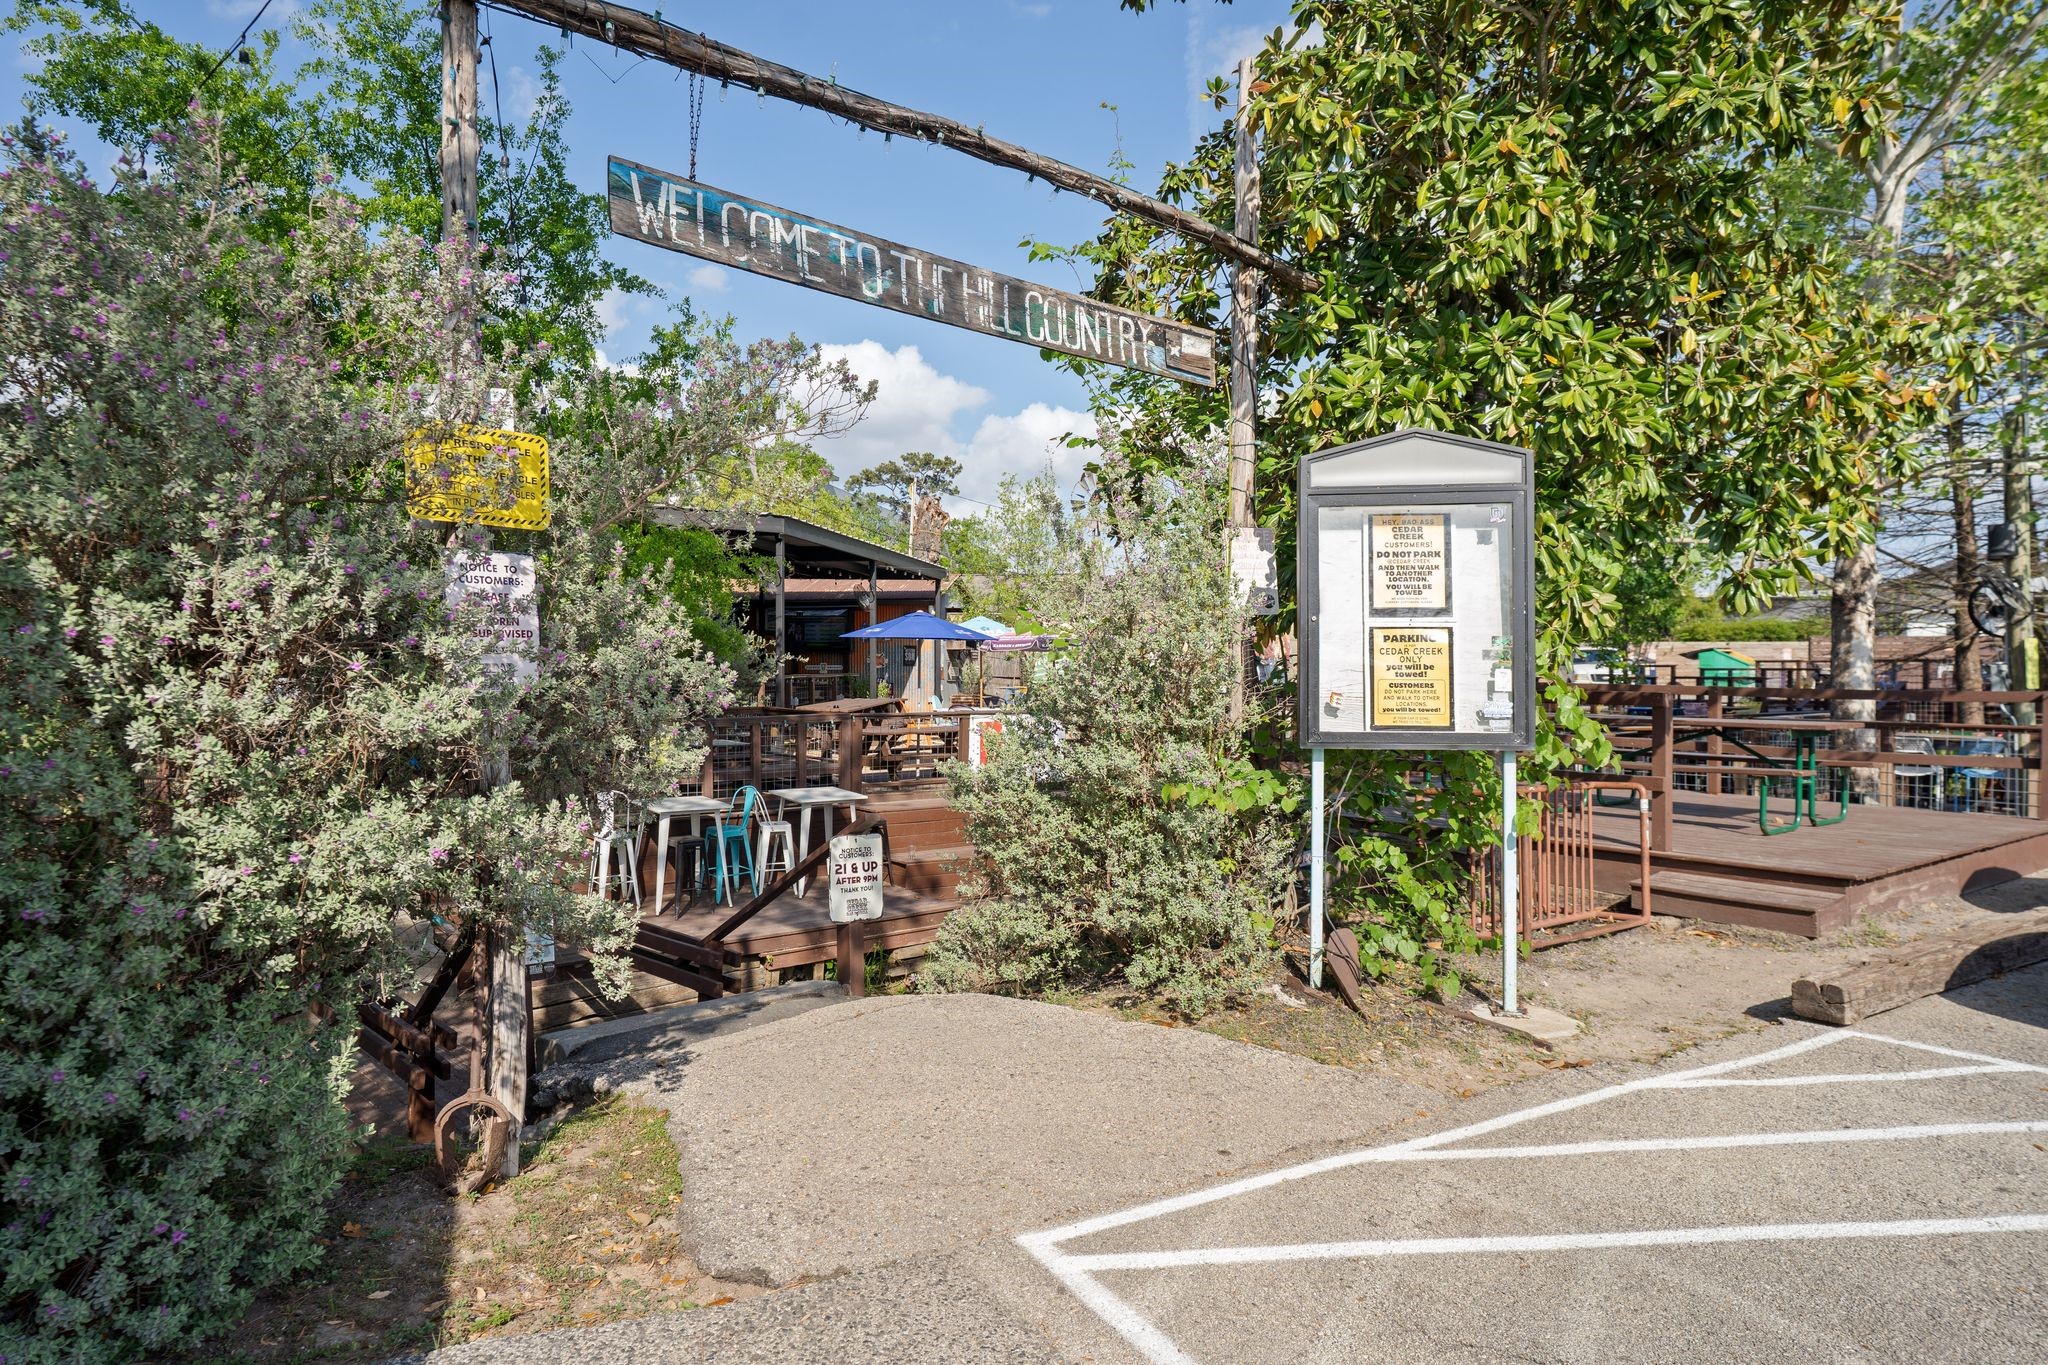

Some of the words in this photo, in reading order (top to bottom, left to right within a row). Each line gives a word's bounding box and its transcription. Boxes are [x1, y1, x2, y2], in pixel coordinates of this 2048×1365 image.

[829, 231, 883, 298] TO
[1024, 291, 1153, 367] COUNTRY
[1413, 550, 1441, 558] PARK
[460, 562, 498, 573] NOTICE
[503, 565, 518, 574] TO
[459, 574, 524, 586] CUSTOMERS:
[1379, 647, 1410, 655] CEDAR
[1412, 647, 1443, 655] CREEK
[1399, 655, 1423, 663] ONLY
[1404, 663, 1422, 671] will
[1423, 663, 1435, 671] be
[838, 851, 874, 859] CUSTOMERS:
[835, 863, 847, 875] 21
[851, 862, 858, 874] &
[862, 861, 878, 873] UP
[836, 876, 861, 885] AFTER
[863, 874, 878, 883] 9PM
